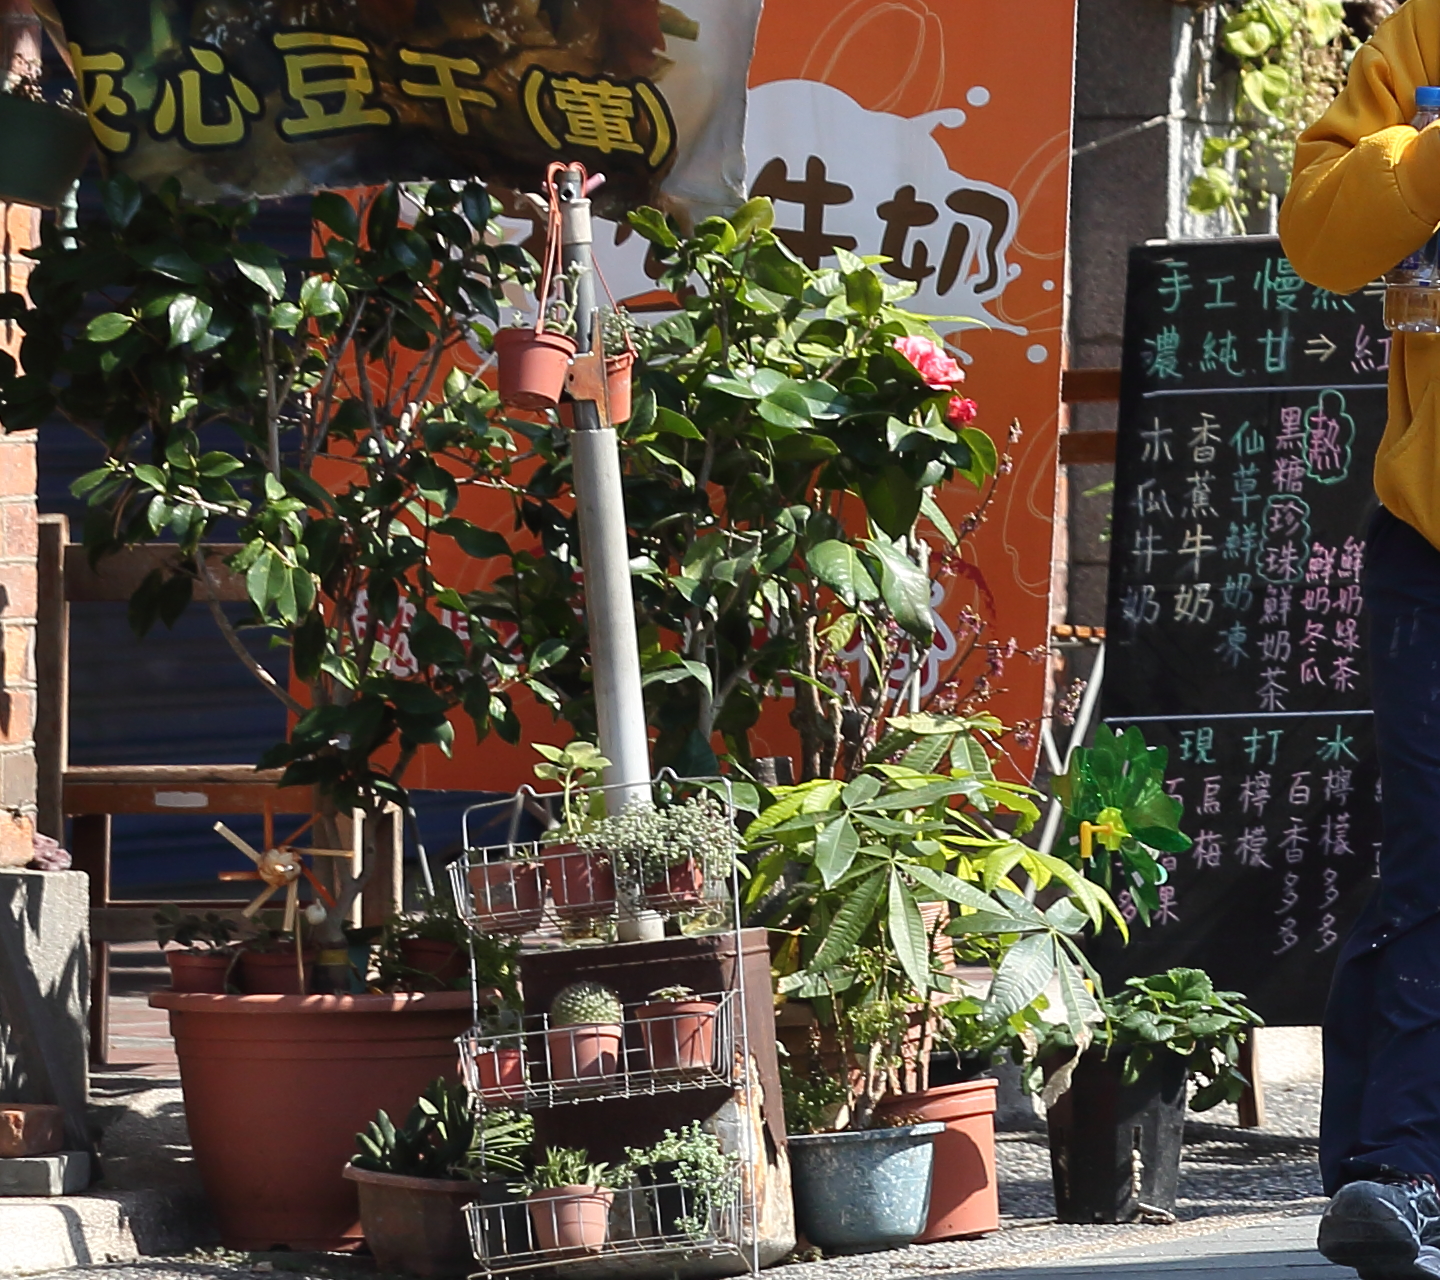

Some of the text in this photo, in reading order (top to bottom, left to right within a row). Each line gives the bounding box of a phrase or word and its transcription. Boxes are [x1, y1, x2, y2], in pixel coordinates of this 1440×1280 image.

[747, 153, 1012, 298] 牛奶
[1121, 416, 1174, 625] 木瓜牛奶
[1174, 411, 1222, 624] 香蕉牛奶
[1179, 724, 1359, 766] 現打冰
[1234, 769, 1273, 870] 檸檬
[1272, 771, 1313, 956] 百香多多
